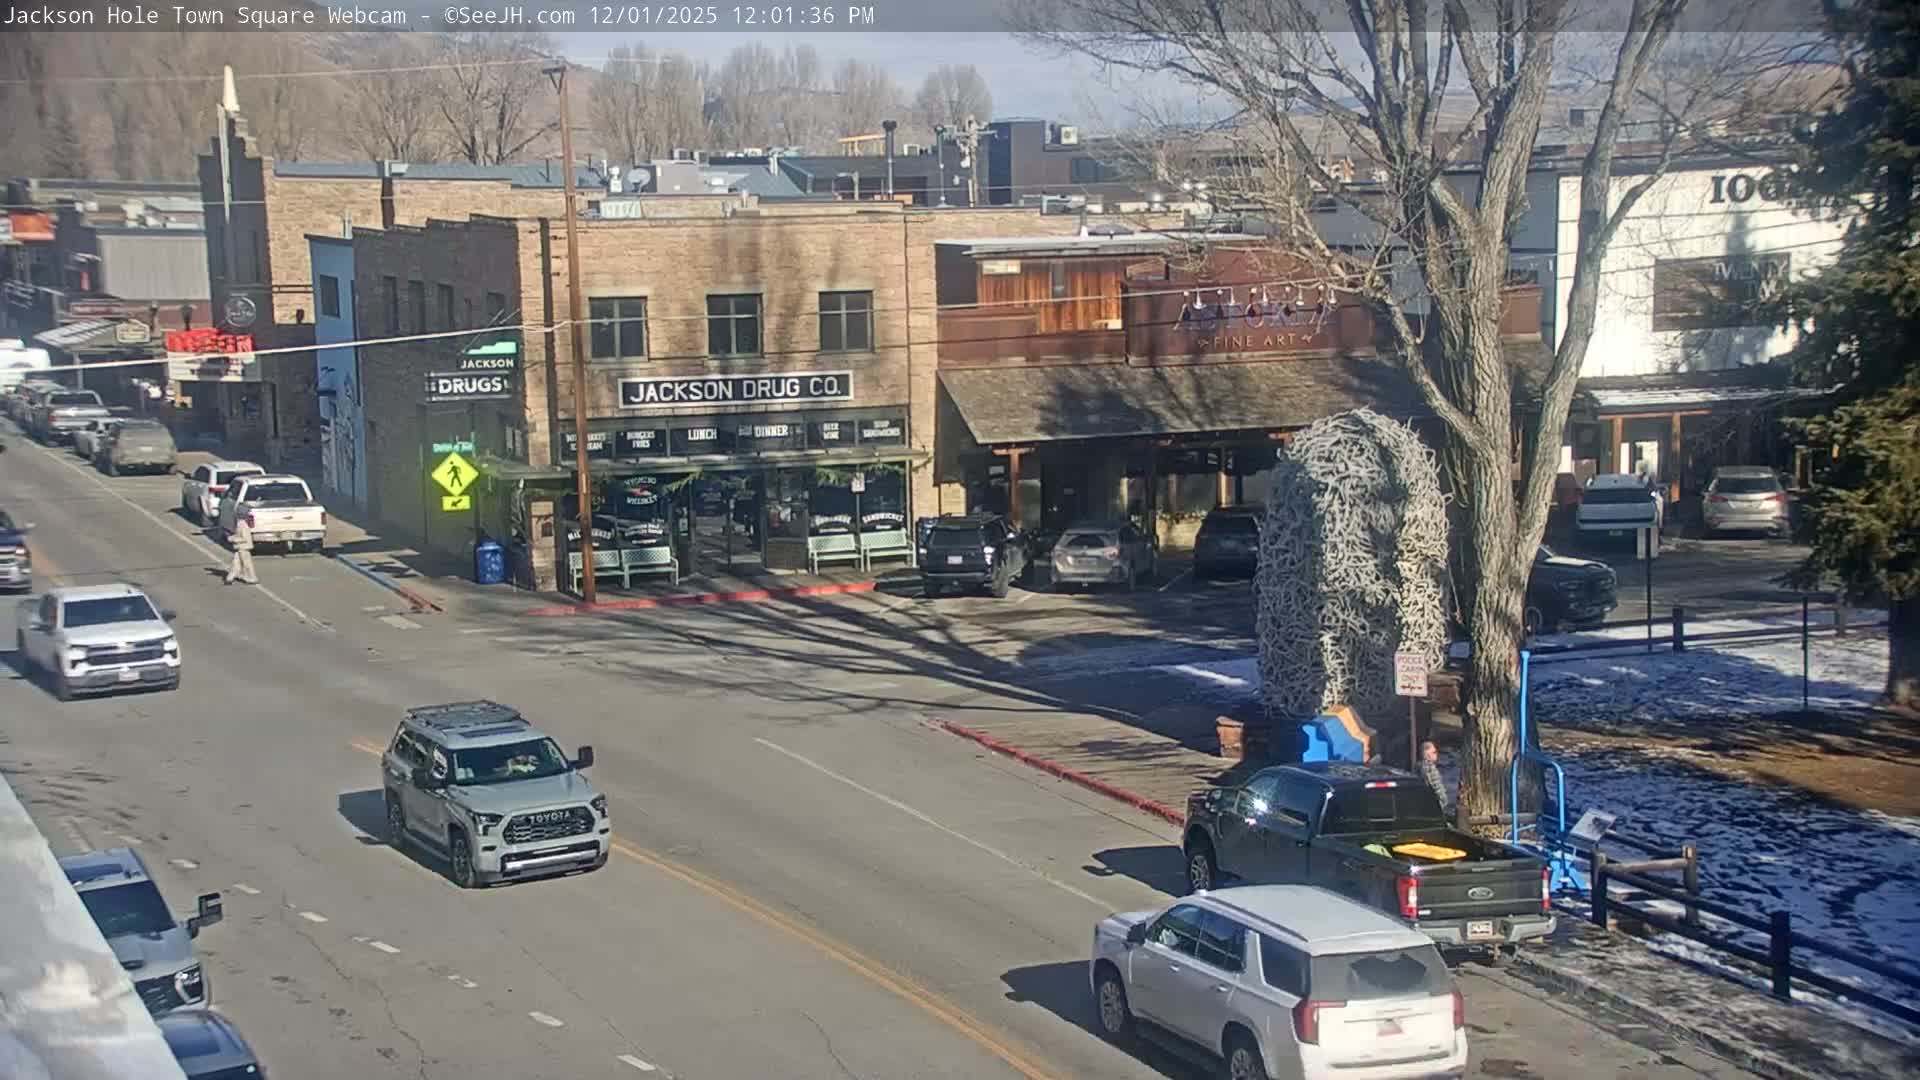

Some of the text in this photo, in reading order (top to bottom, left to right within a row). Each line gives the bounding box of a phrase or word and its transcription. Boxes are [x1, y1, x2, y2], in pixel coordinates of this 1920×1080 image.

[1709, 172, 1790, 205] IOO
[1213, 333, 1297, 349] FINE ART
[460, 359, 514, 370] JACKSON
[438, 376, 503, 394] DRUGS
[629, 376, 841, 403] JACKSON DRUG CO.
[687, 428, 717, 441] LUNCH
[754, 424, 789, 438] DINNER
[529, 810, 571, 825] TOYOTA
